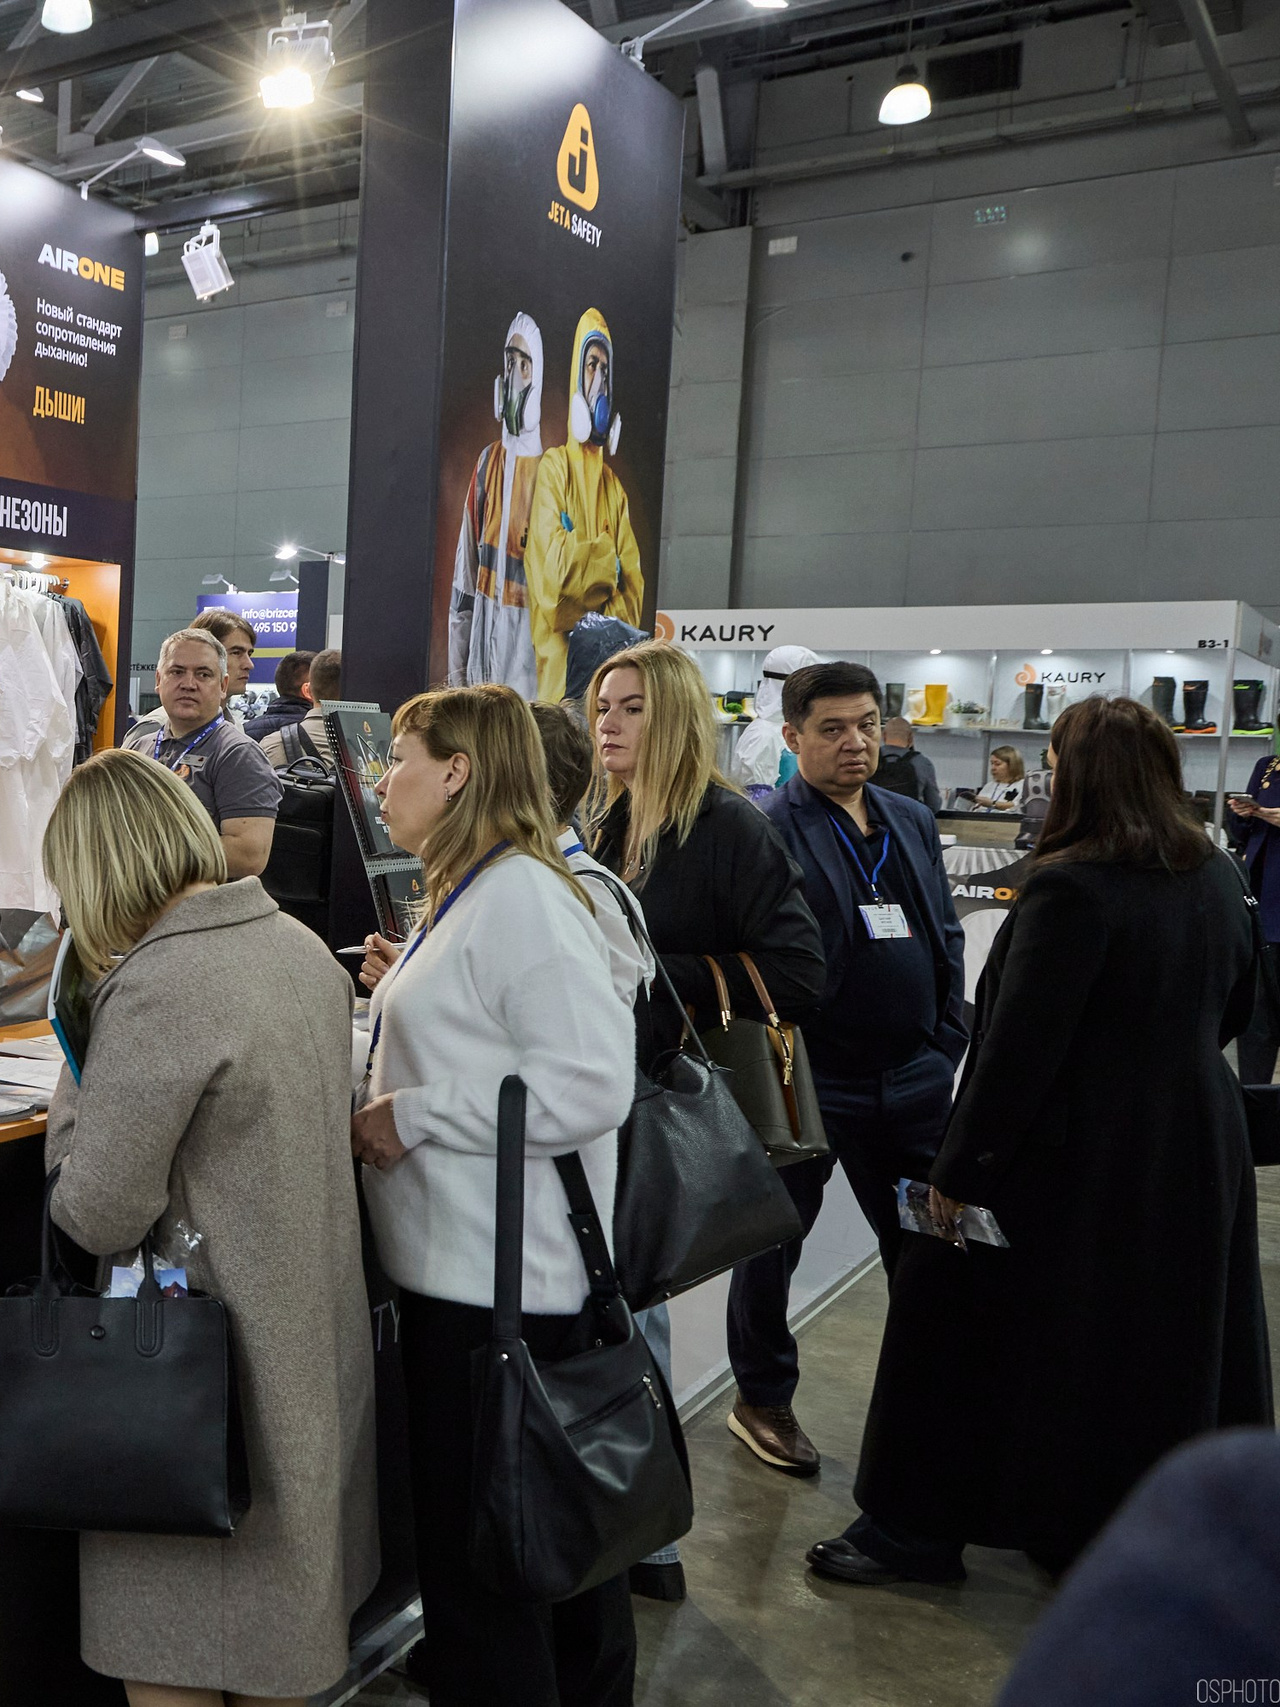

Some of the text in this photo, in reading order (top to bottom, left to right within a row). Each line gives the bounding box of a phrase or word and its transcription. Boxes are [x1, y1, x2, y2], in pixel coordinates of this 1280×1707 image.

[548, 201, 602, 247] JETA SAFETY
[37, 243, 125, 292] AIRONE
[36, 297, 122, 340] Новый стандарт
[35, 321, 117, 356] сопротивления
[34, 342, 88, 368] дыханию!
[32, 385, 86, 425] ДЫШИ!
[253, 621, 297, 633] 495 150 9
[681, 625, 775, 642] KAURY
[1041, 672, 1106, 683] KAURY
[951, 884, 1019, 901] AIRO
